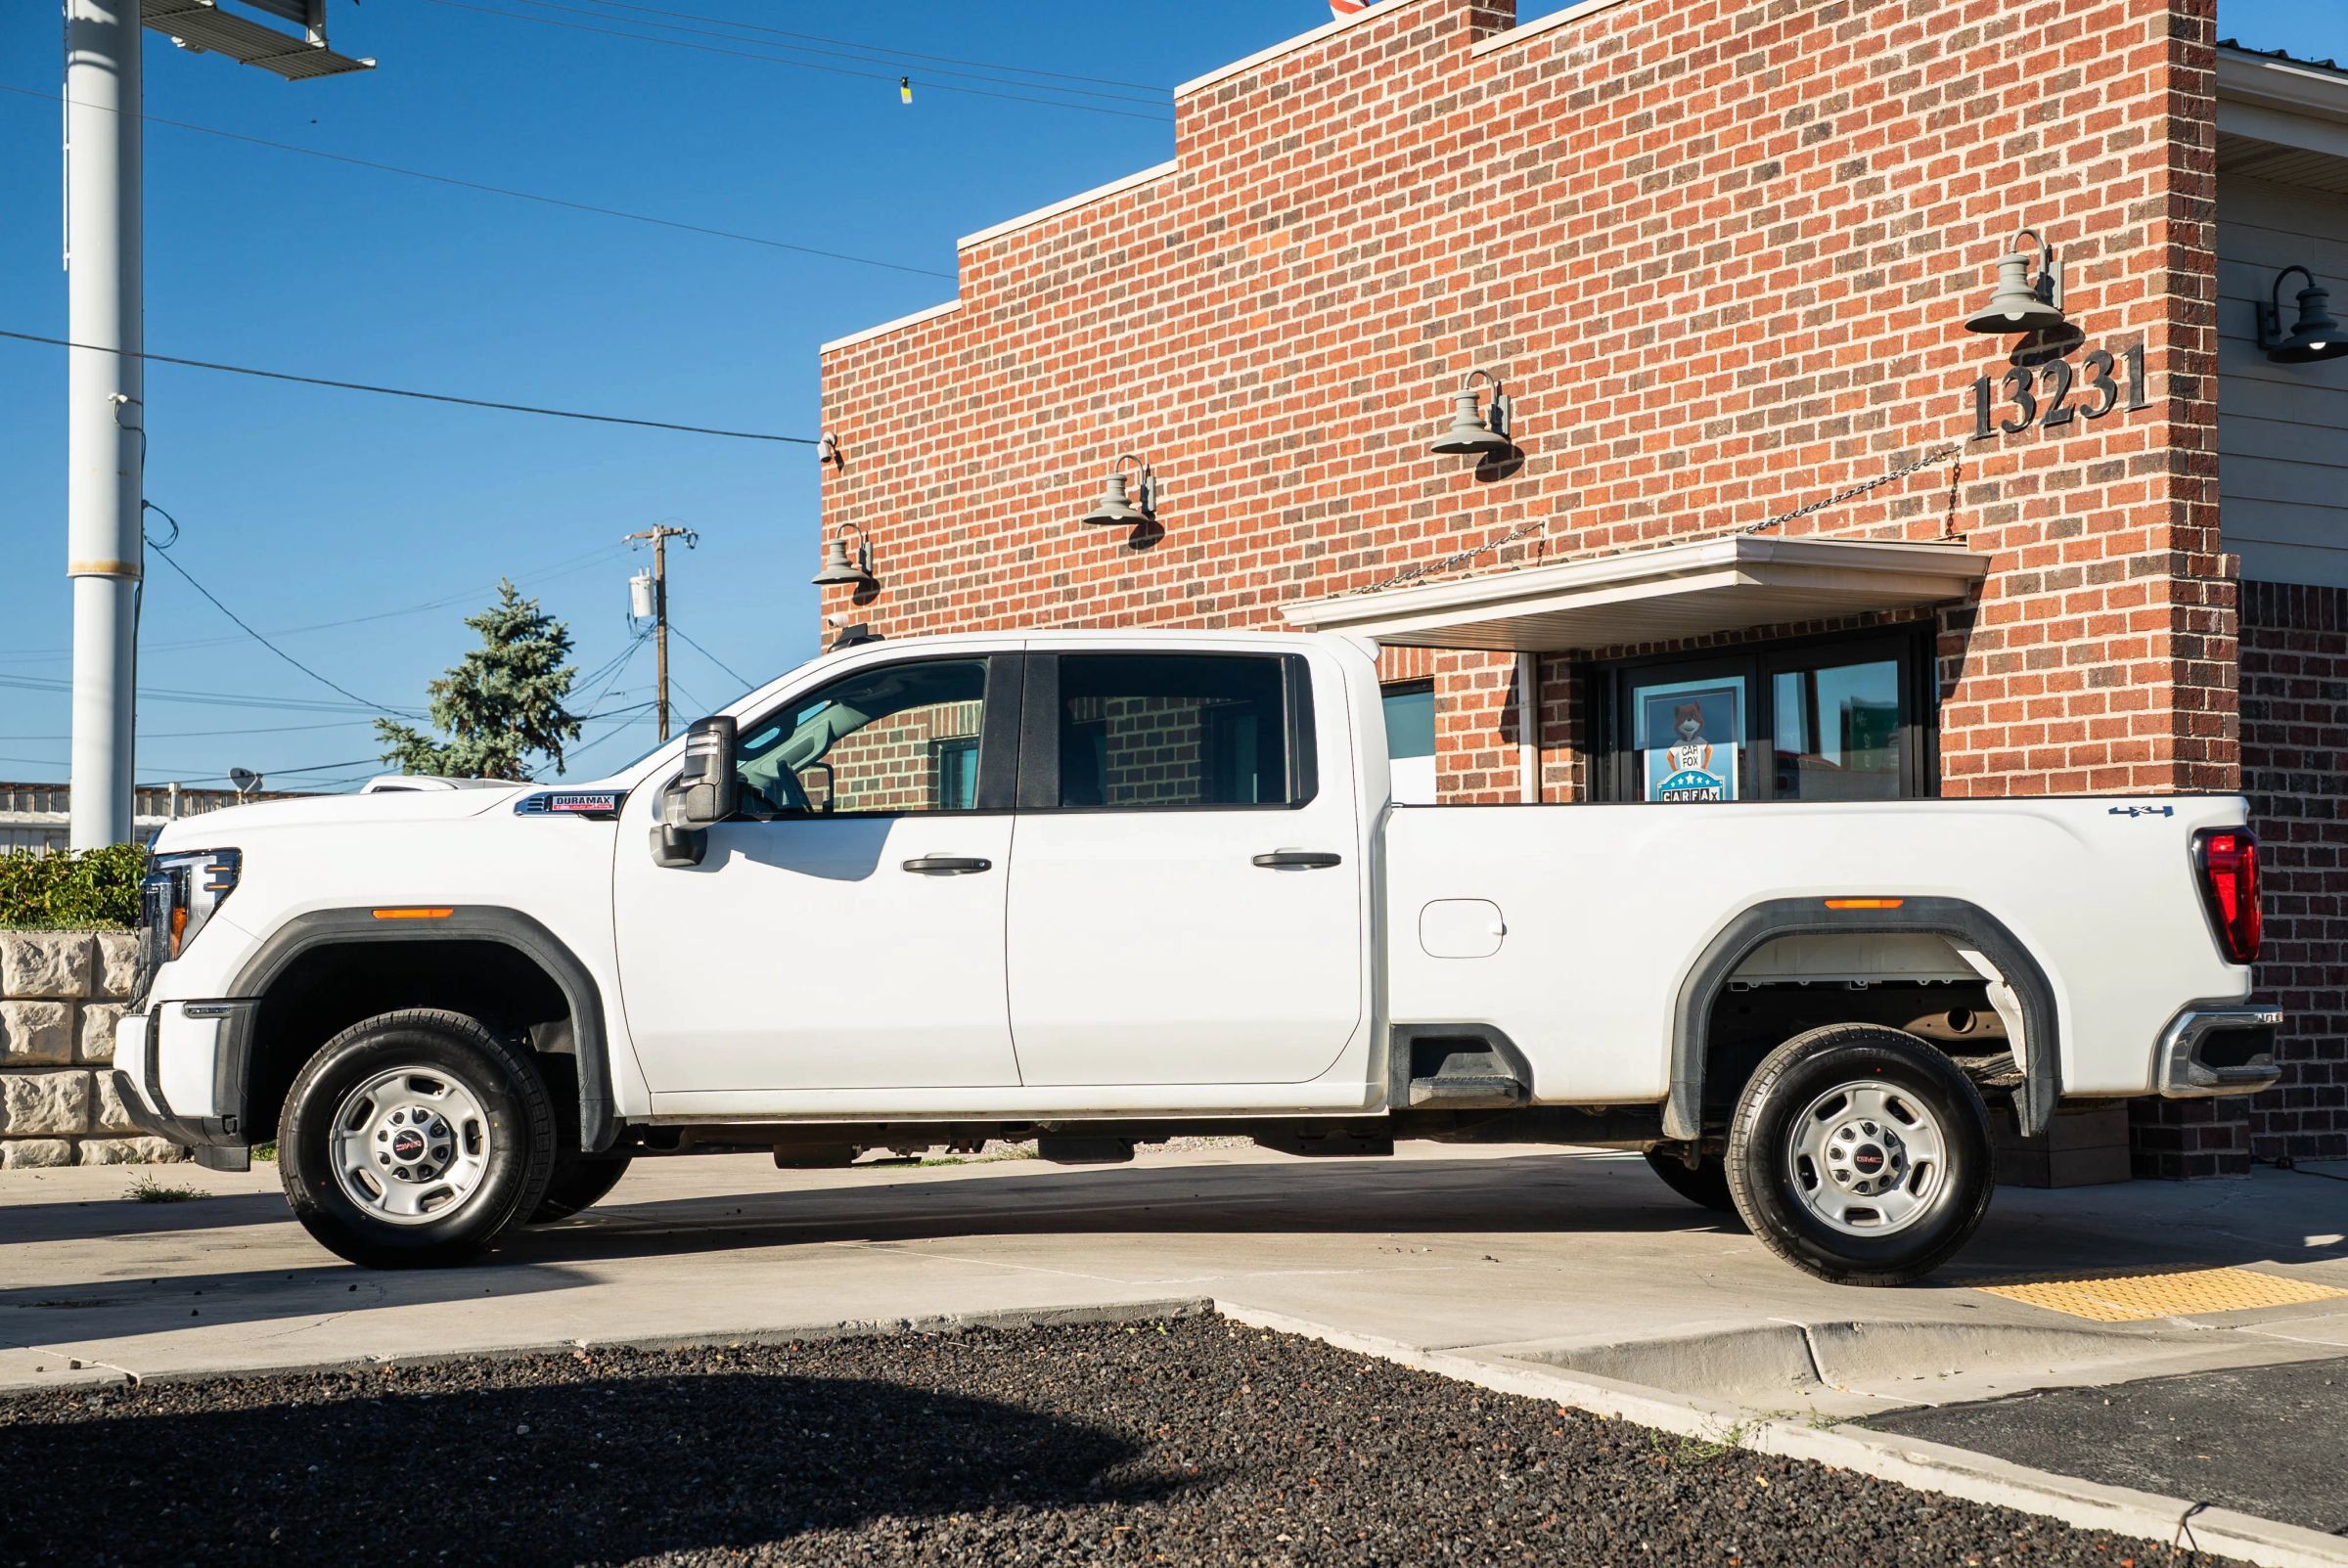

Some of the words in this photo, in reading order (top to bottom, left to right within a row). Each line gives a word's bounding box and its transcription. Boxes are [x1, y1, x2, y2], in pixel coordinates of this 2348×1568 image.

[1968, 344, 2152, 440] 13231
[1682, 745, 1698, 757] CAR
[1682, 756, 1698, 767] FOX
[557, 796, 611, 805] DURAMAX
[1663, 789, 1719, 802] CARFAX
[395, 1140, 422, 1151] GMC
[1856, 1155, 1882, 1164] GMC
